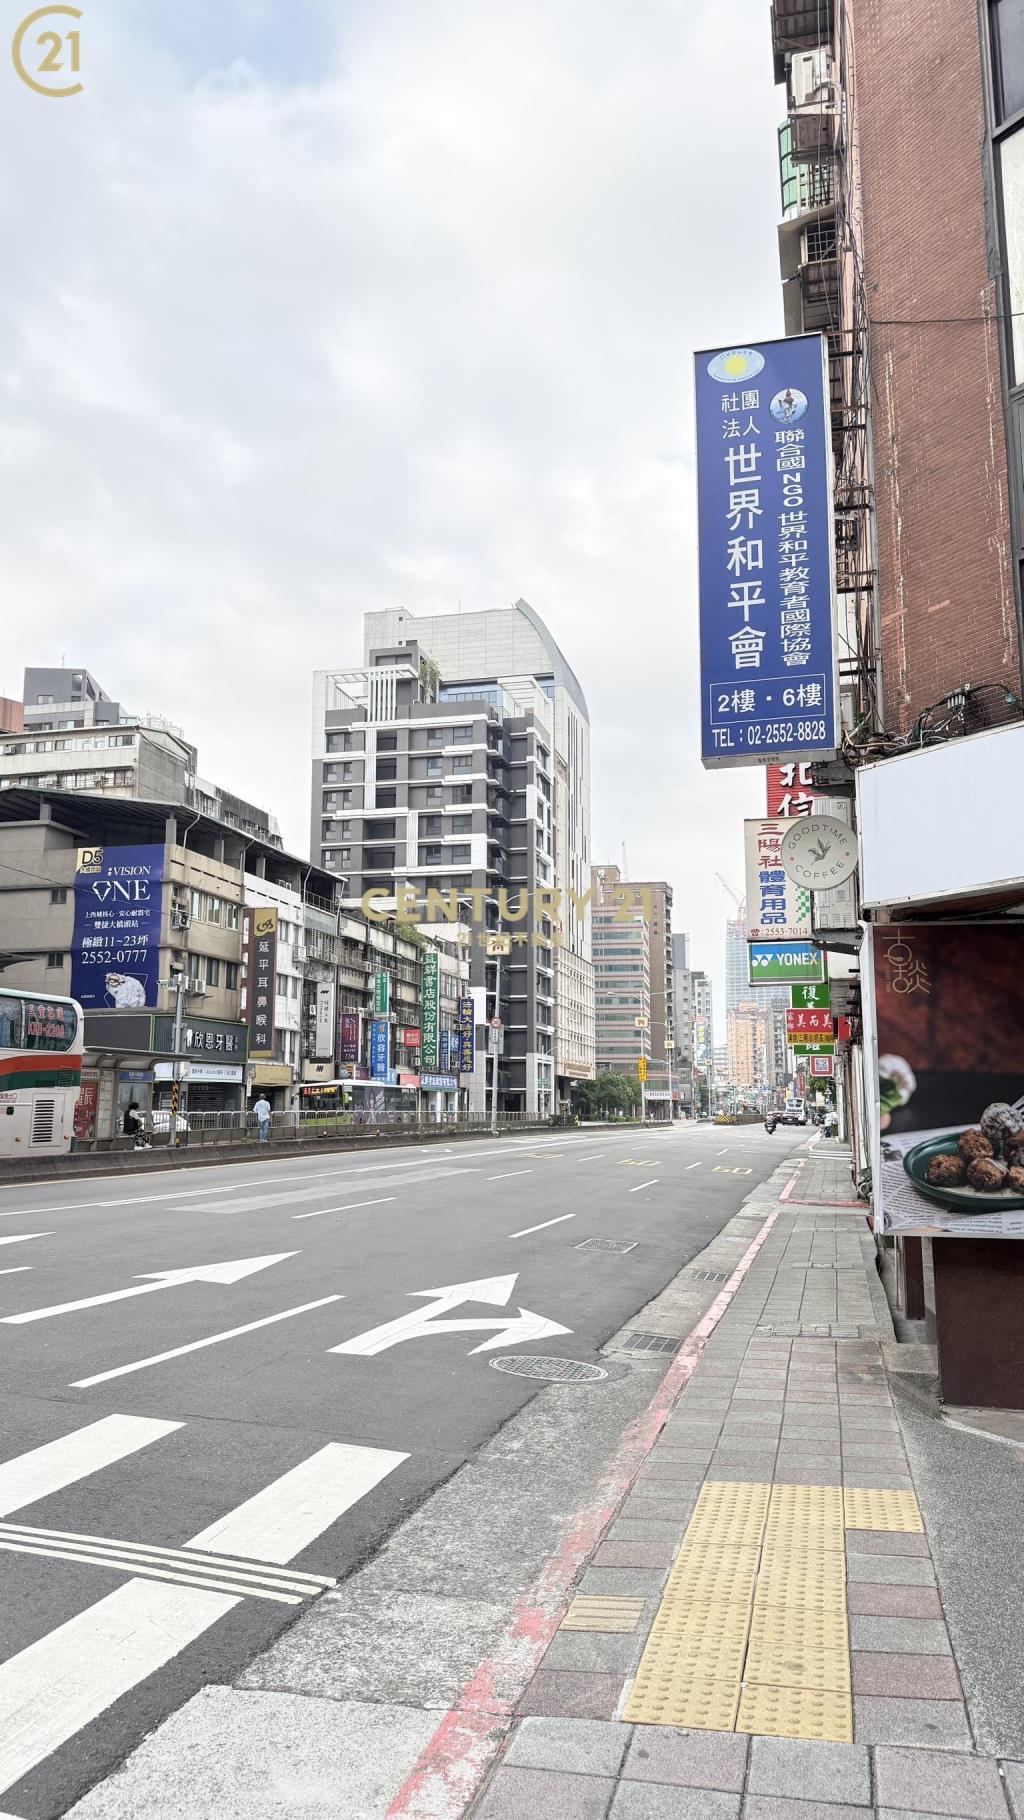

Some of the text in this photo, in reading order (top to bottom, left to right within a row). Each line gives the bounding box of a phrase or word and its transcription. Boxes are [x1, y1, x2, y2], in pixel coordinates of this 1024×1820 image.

[721, 389, 760, 413] 社團
[722, 415, 761, 439] 法人
[724, 443, 767, 670] 世界和平會
[81, 848, 104, 865] D5
[113, 866, 152, 876] VISION
[795, 860, 845, 880] COFFEE
[81, 949, 147, 965] 2552-0777
[777, 952, 818, 967] YONEX
[255, 941, 270, 1045] 延平耳鼻喉科
[423, 954, 437, 1066] 益群書店股份有限公司
[796, 1013, 833, 1029] 美而美
[194, 1031, 234, 1051] 欣恩牙醫
